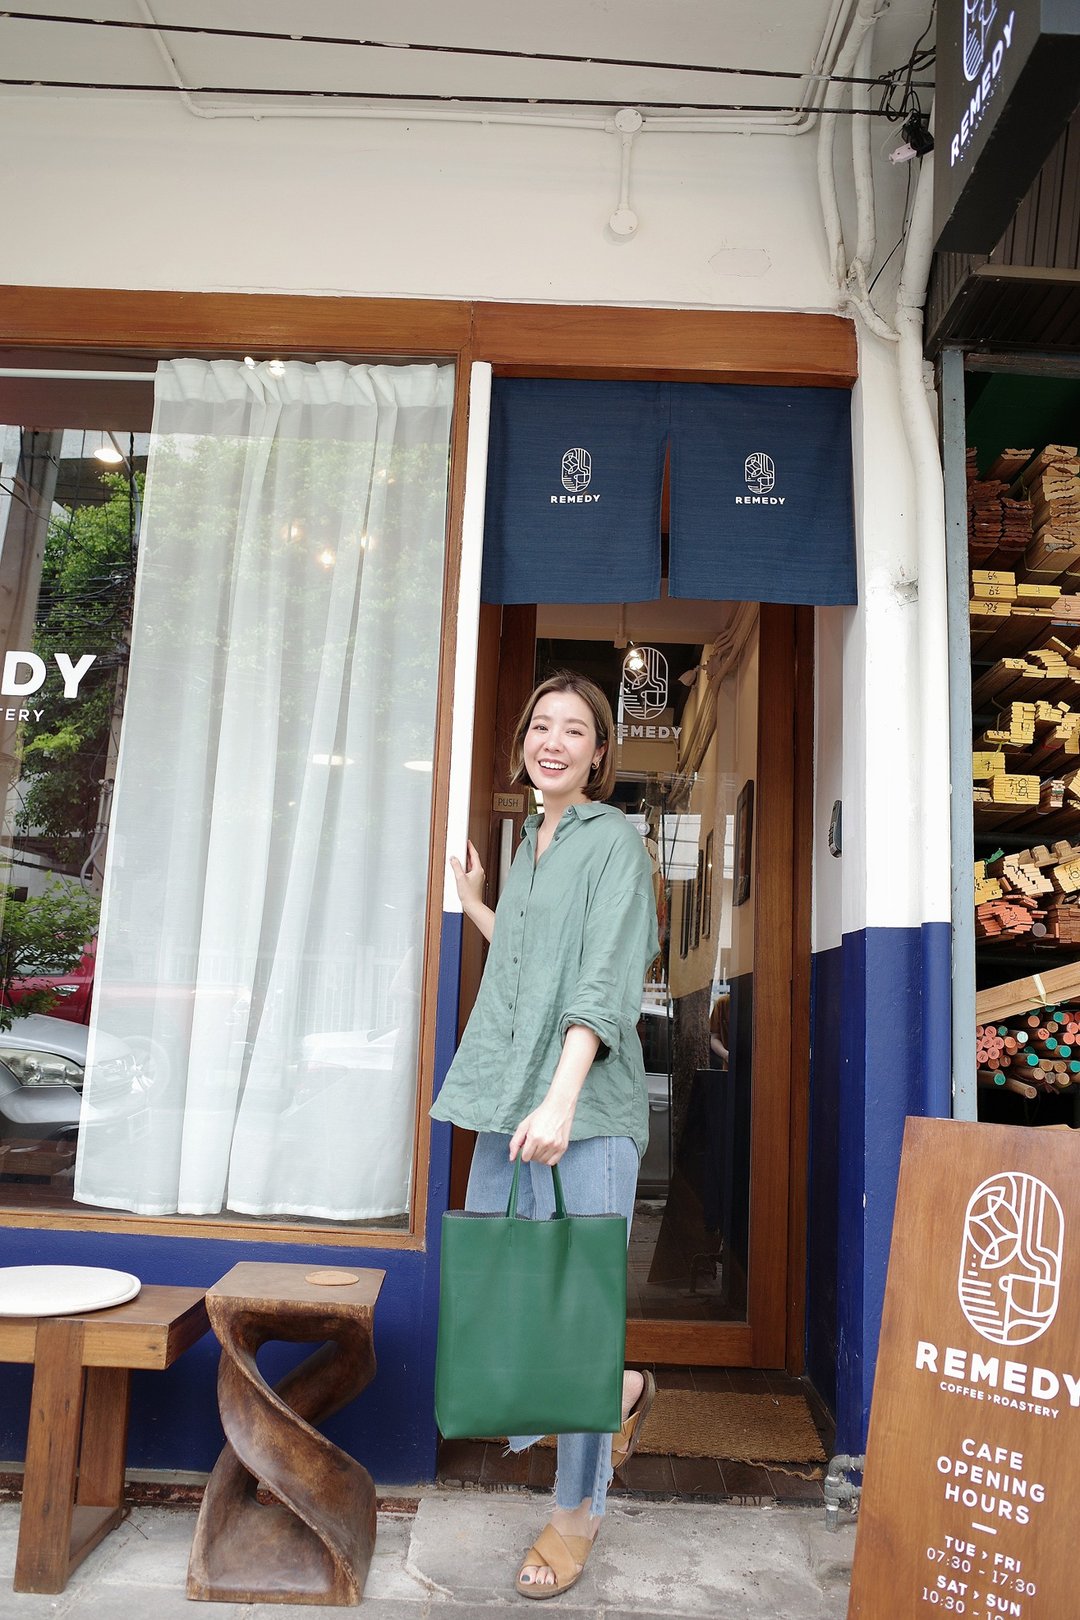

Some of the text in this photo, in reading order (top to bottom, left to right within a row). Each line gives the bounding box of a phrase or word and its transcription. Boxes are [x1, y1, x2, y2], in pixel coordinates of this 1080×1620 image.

[950, 9, 1015, 167] REMEDY
[550, 494, 600, 504] REMEDY
[735, 496, 786, 505] REMEDY
[0, 708, 45, 722] ERY
[612, 724, 682, 739] EMEDY
[498, 798, 518, 806] PUSH
[940, 1381, 1059, 1418] COFFEE ROASTERY
[962, 1438, 1023, 1470] CAFE
[937, 1455, 1045, 1502] OPENING
[945, 1482, 1029, 1524] HOURS
[944, 1535, 1021, 1572] TUE FRI
[927, 1547, 970, 1572] 07:30
[992, 1570, 1036, 1596] 17:30
[922, 1587, 965, 1613] 10:30
[937, 1575, 1021, 1617] SAT SUN
